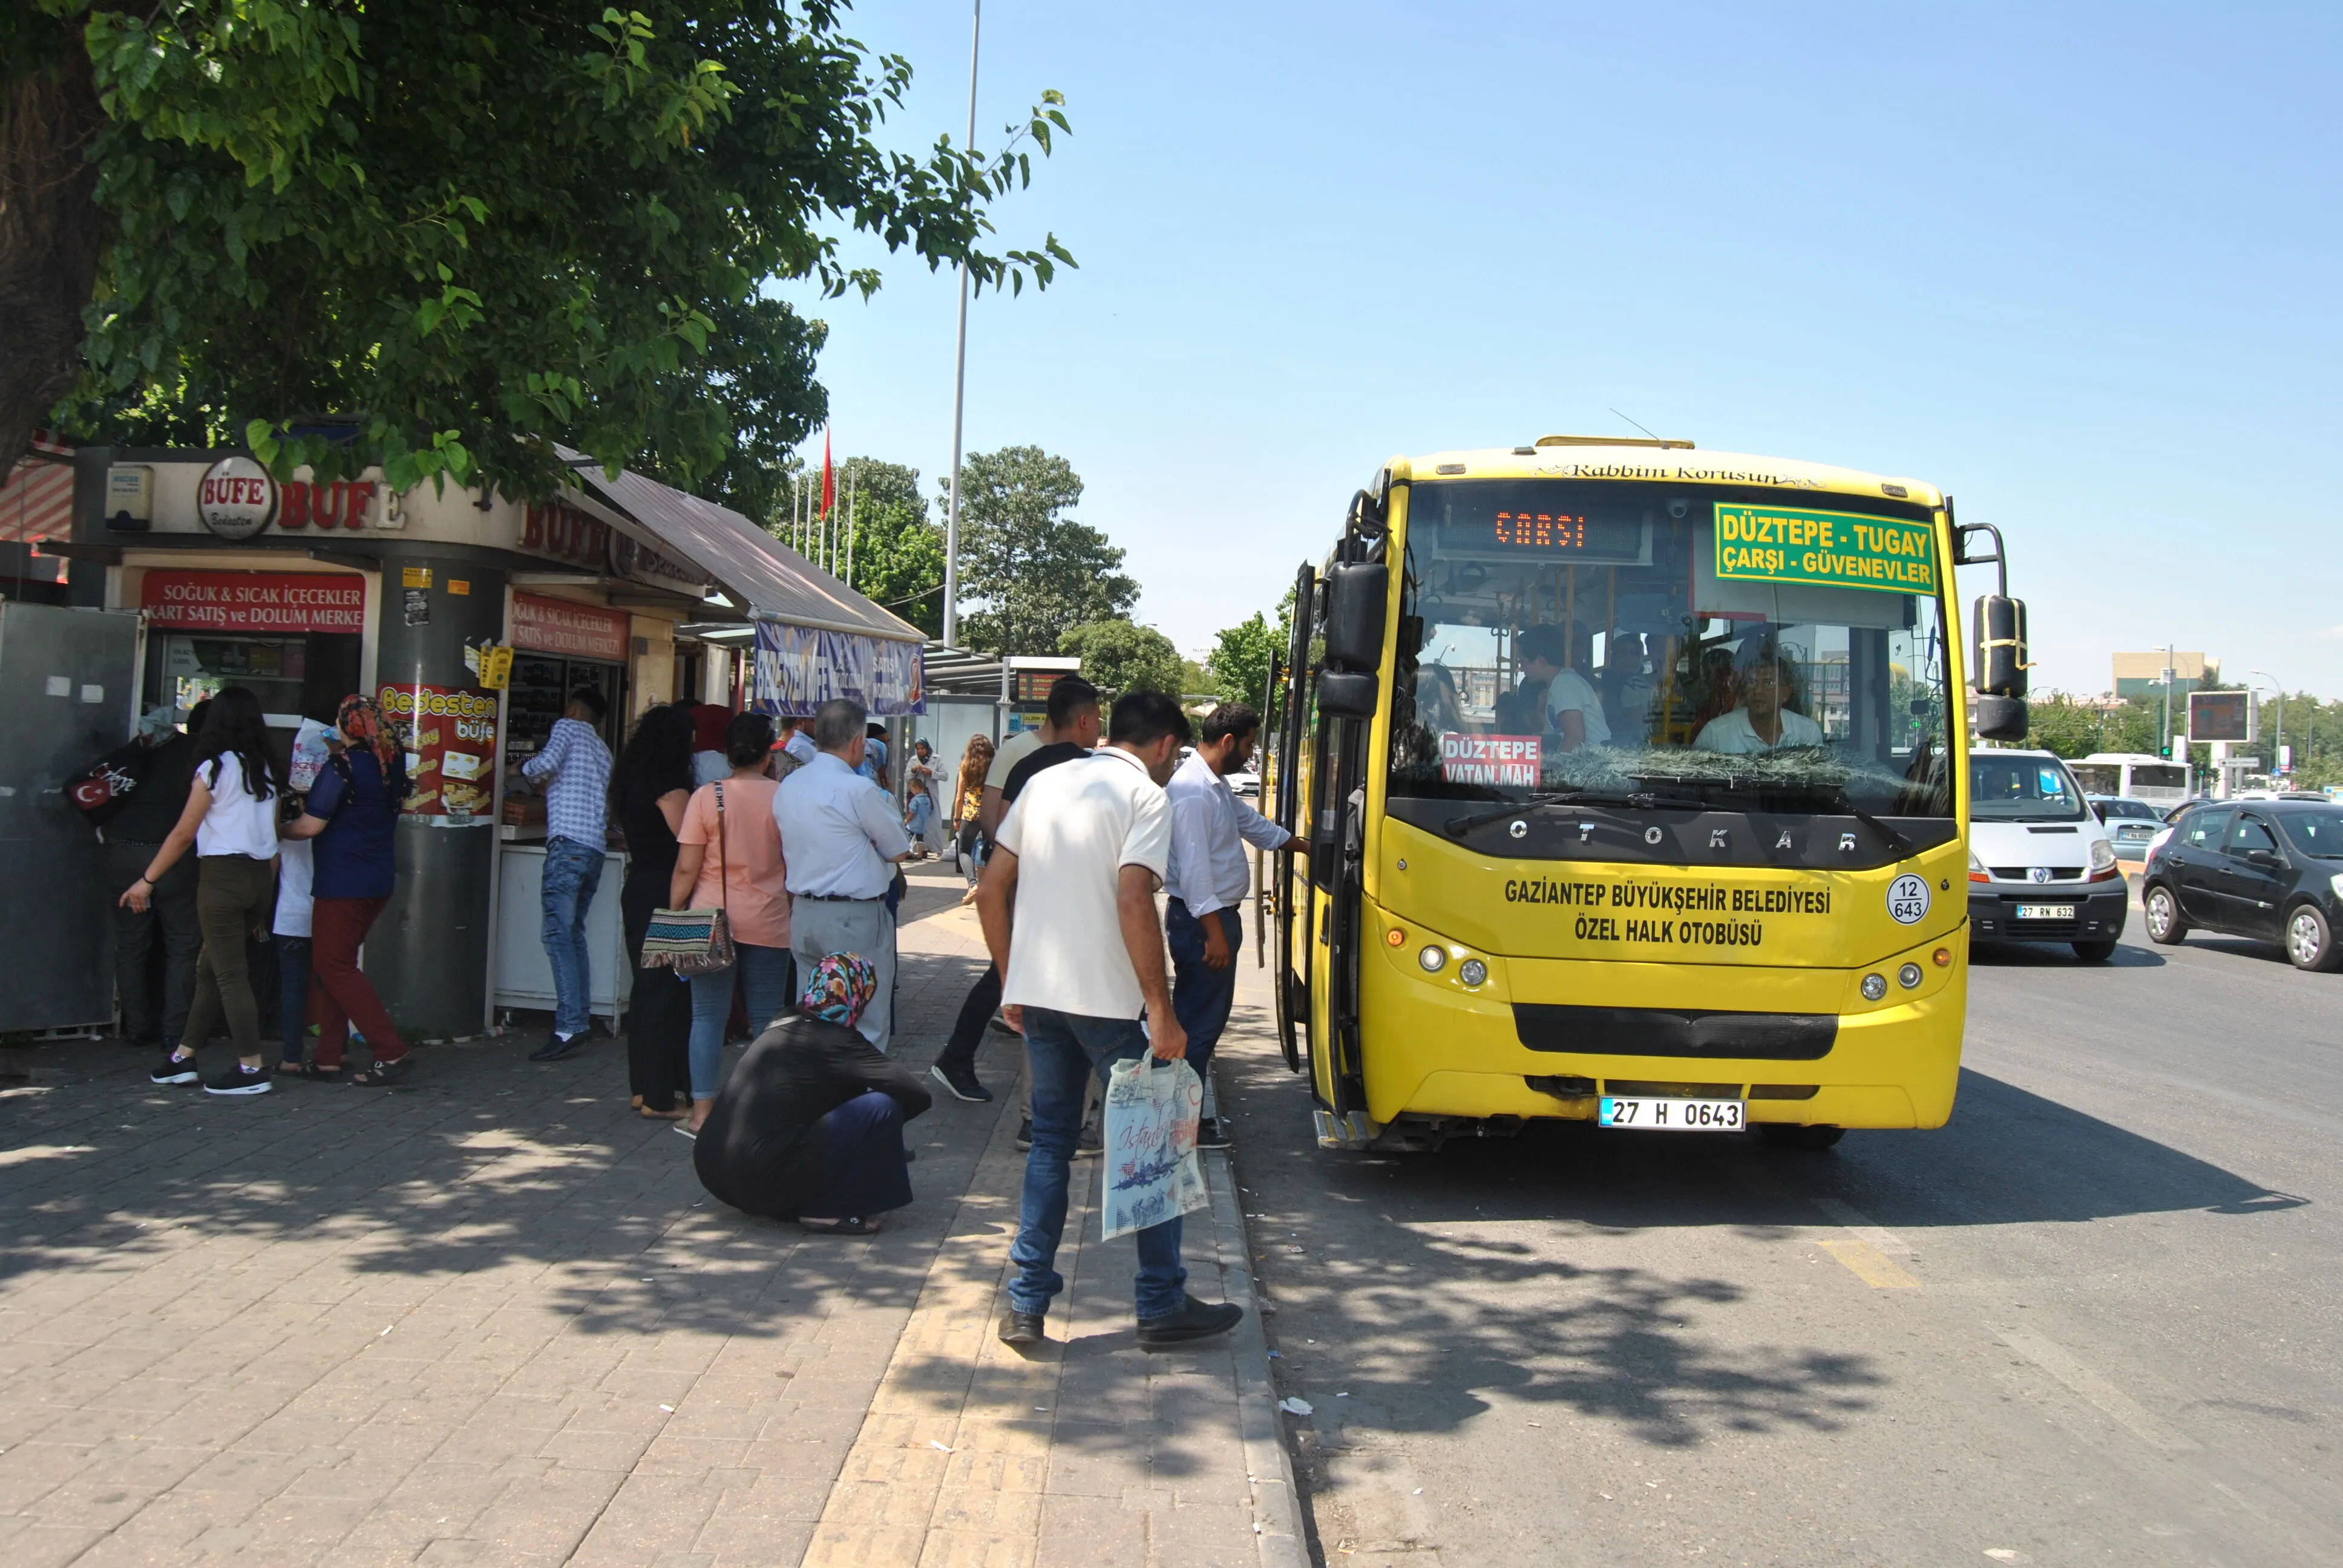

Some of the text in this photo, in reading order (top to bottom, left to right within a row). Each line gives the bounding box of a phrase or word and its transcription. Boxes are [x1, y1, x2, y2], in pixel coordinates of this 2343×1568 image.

[1573, 464, 1778, 485] Rabbim Korusun
[204, 472, 264, 505] BÜFE
[1722, 510, 1833, 547] DÜZTEPE
[1853, 524, 1927, 558] TUGAY
[1723, 546, 1784, 575] ÇARŞI
[1803, 549, 1932, 584] GÜVENEVLER
[163, 581, 361, 609] SOĞUK & SICAK İÇECEKLER
[148, 604, 185, 620] KART
[188, 607, 226, 626] SATIŞ
[231, 611, 246, 623] ve
[250, 608, 307, 624] DOLUM
[547, 607, 572, 627] SICAK
[519, 625, 542, 650] SATIŞ
[555, 632, 586, 652] DOLUM
[381, 687, 497, 718] Bedesten
[456, 718, 496, 745] büfe
[1446, 737, 1538, 760] DÜZTEPE
[1510, 820, 1856, 852] OTOKAR
[1505, 875, 1830, 915] GAZİANTEP BÜYÜKŞEHİR BELEDİYESİ
[1899, 881, 1918, 897] 12
[1895, 902, 1922, 917] 643
[2022, 907, 2073, 917] 27 RN 632
[1575, 912, 1762, 946] ÖZEL HALK OTOBÜSÜ
[1613, 1102, 1639, 1123] 27
[1656, 1103, 1668, 1124] H
[1685, 1103, 1738, 1126] 0643
